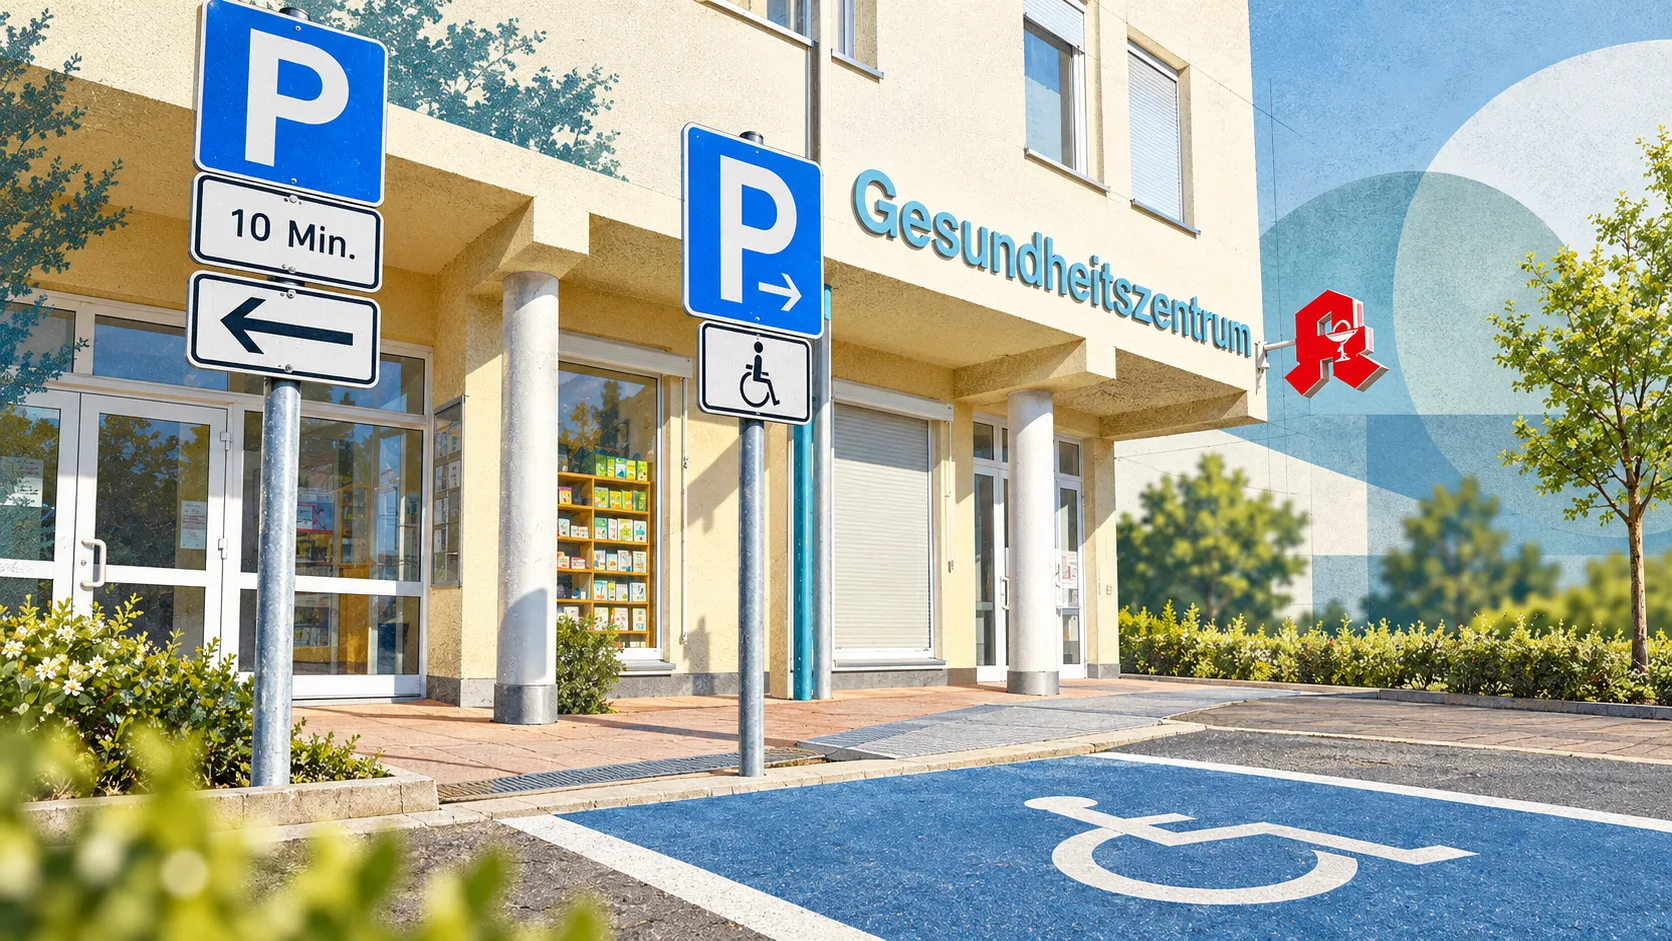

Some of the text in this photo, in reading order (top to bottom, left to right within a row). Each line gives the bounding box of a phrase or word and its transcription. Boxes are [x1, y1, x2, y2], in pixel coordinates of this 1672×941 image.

[245, 28, 350, 167] P
[231, 208, 356, 260] 10 Min.
[719, 154, 798, 304] P
[851, 168, 1253, 358] Gesundheitszentrum
